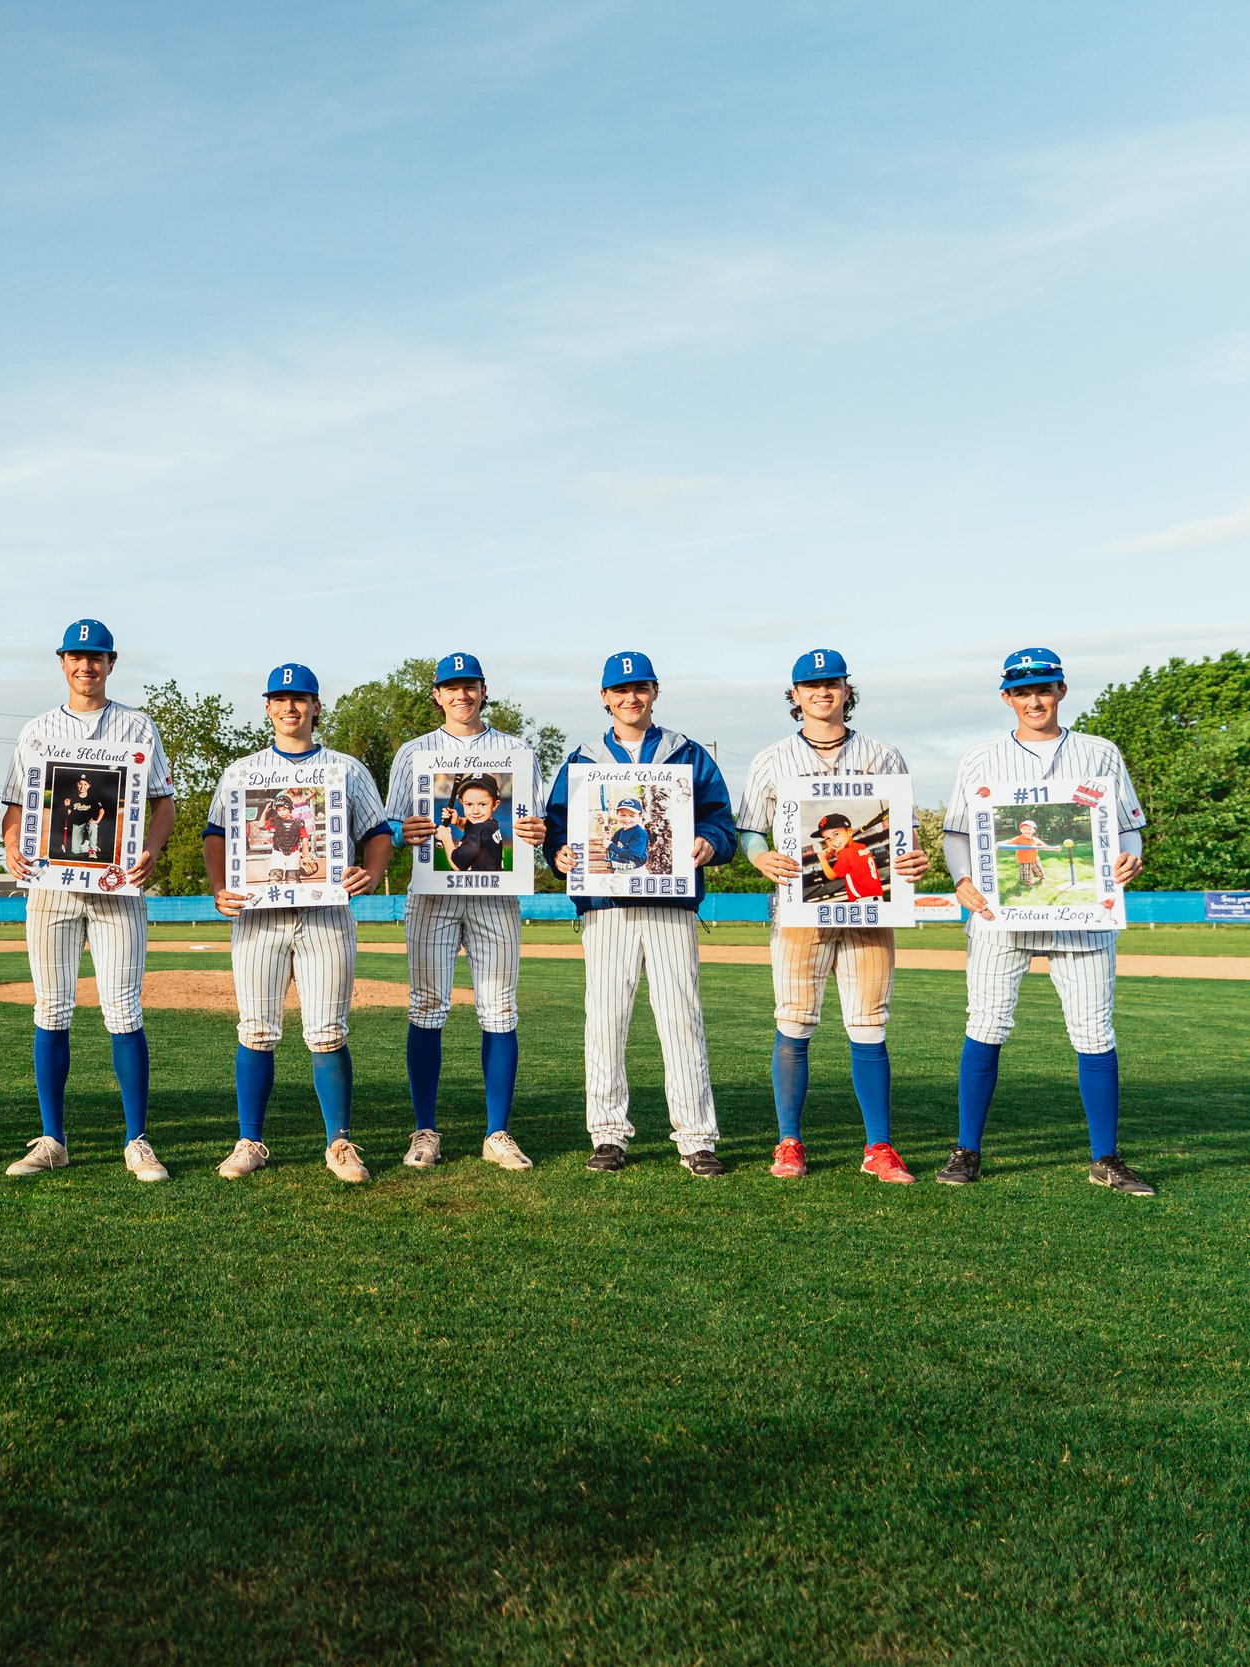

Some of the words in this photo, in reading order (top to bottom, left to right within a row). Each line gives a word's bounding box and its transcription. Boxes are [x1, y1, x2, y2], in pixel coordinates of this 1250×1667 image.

[79, 625, 89, 641] B
[454, 656, 464, 671] B
[622, 658, 633, 674] B
[814, 652, 825, 668] B
[283, 668, 293, 684] B
[40, 745, 72, 759] Nate
[77, 747, 128, 762] Holland
[429, 756, 460, 769] Noah
[464, 756, 512, 769] Hancock
[248, 772, 289, 788] Dylan
[587, 770, 631, 782] Patrick
[635, 770, 672, 782] Walsh
[812, 782, 874, 797] SENIOR
[1014, 786, 1049, 804] #11
[23, 767, 41, 858] 2025
[418, 775, 431, 863] 205
[782, 801, 798, 834] Drew
[126, 773, 141, 871] SENIOR
[230, 790, 241, 888] SENIOR
[330, 789, 343, 886] 2025
[975, 811, 995, 894] 2025
[1098, 806, 1115, 893] SENIOR
[447, 874, 500, 888] SENIOR
[629, 876, 688, 895] 2025
[268, 885, 295, 905] #9
[818, 905, 878, 925] 2025
[1000, 908, 1050, 922] Tristan
[1054, 908, 1094, 923] Loop
